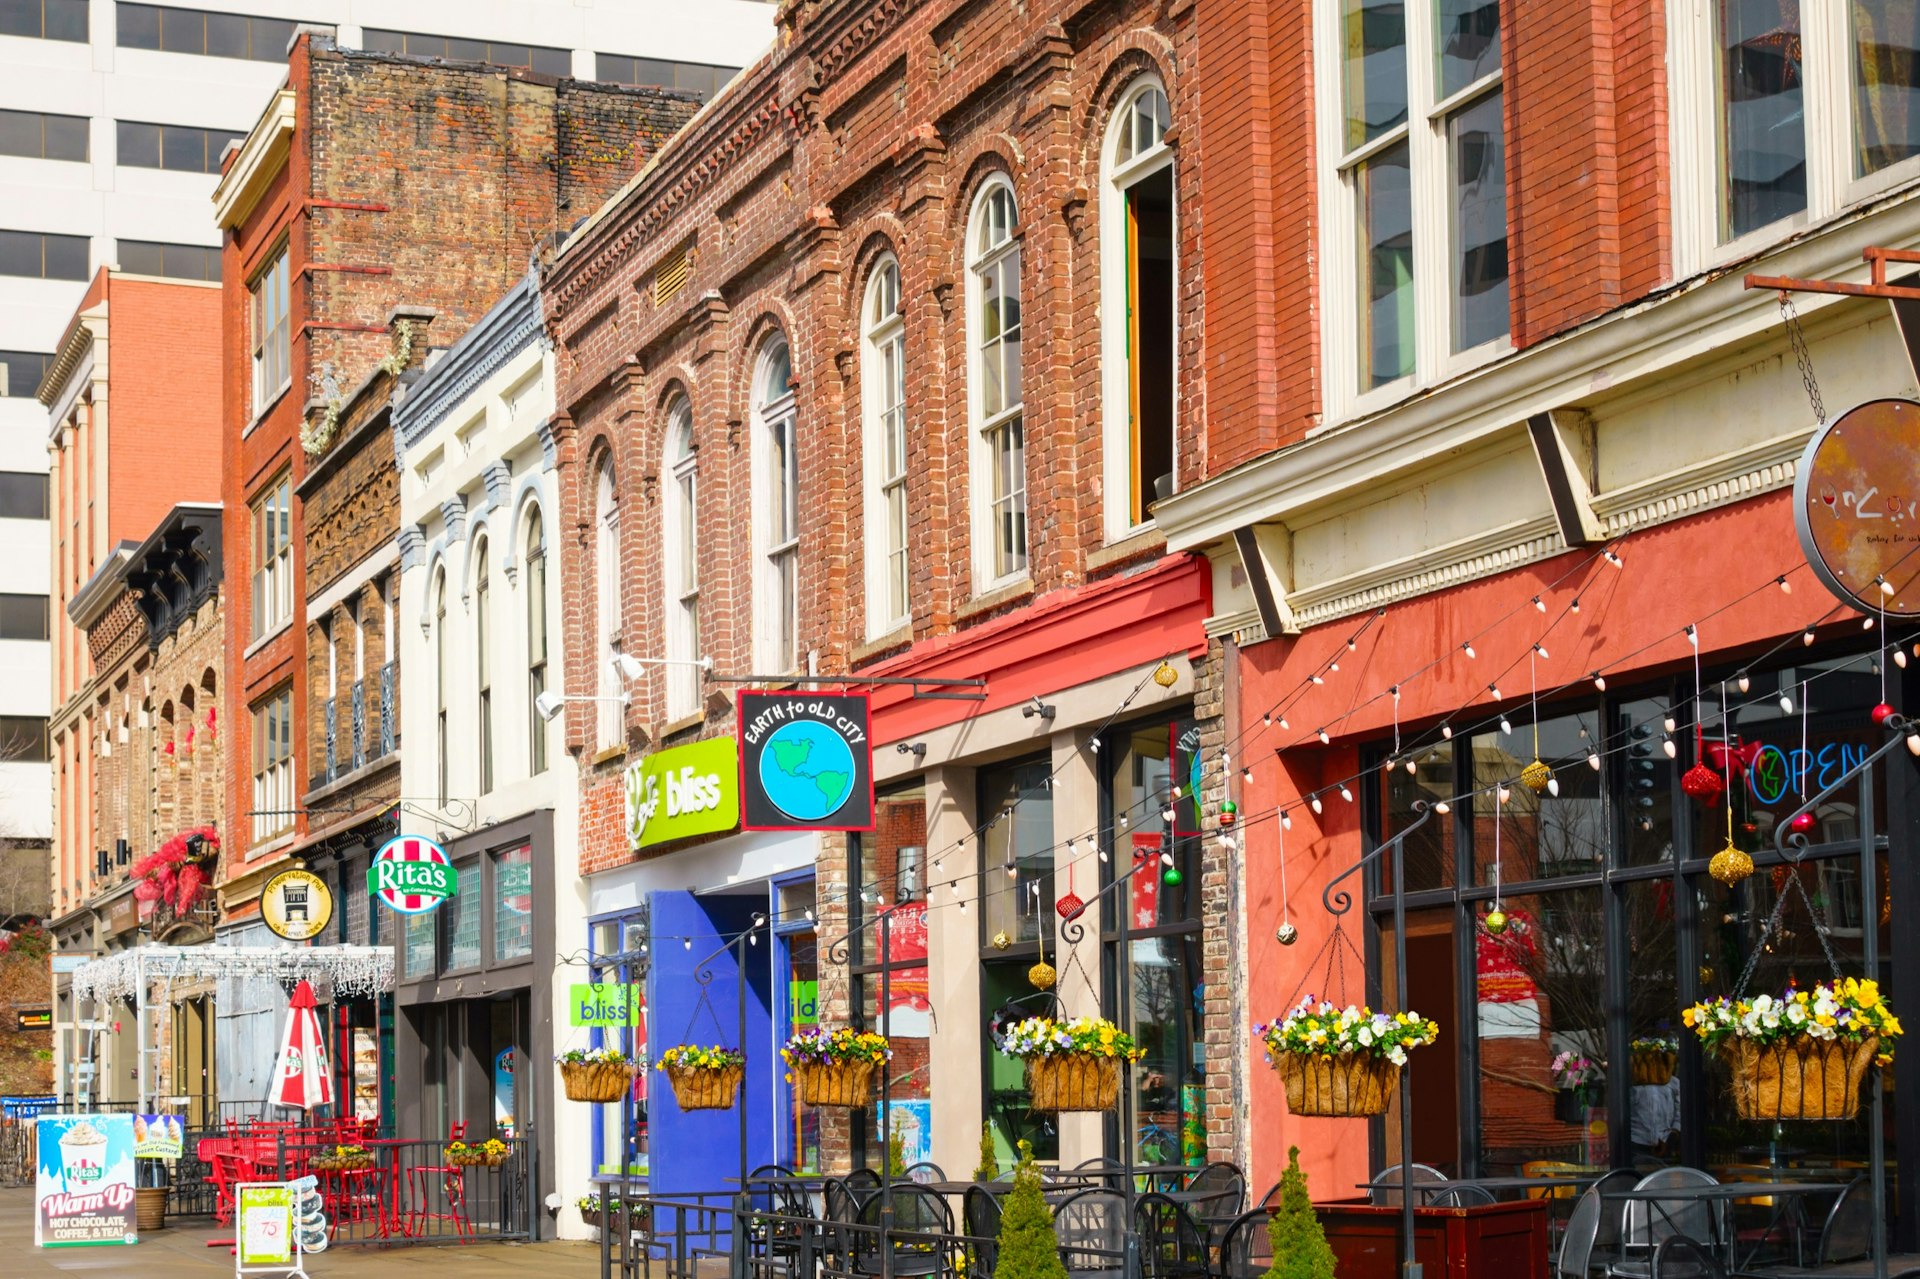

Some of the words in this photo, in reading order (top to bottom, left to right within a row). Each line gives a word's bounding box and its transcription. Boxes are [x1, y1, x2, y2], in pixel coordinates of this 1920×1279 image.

[744, 704, 785, 744] EARTH
[836, 716, 866, 744] CITY
[1751, 744, 1868, 804] OPEN
[666, 766, 721, 817] bliss
[378, 860, 447, 891] Rita's
[581, 1000, 627, 1020] bliss
[71, 1165, 99, 1177] Rita's
[42, 1193, 103, 1217] Warm
[104, 1184, 134, 1210] Up
[50, 1218, 68, 1228] HOT
[70, 1216, 127, 1227] CHOCOLATE,
[54, 1227, 91, 1239] COFFEE,
[102, 1227, 123, 1237] TEA!
